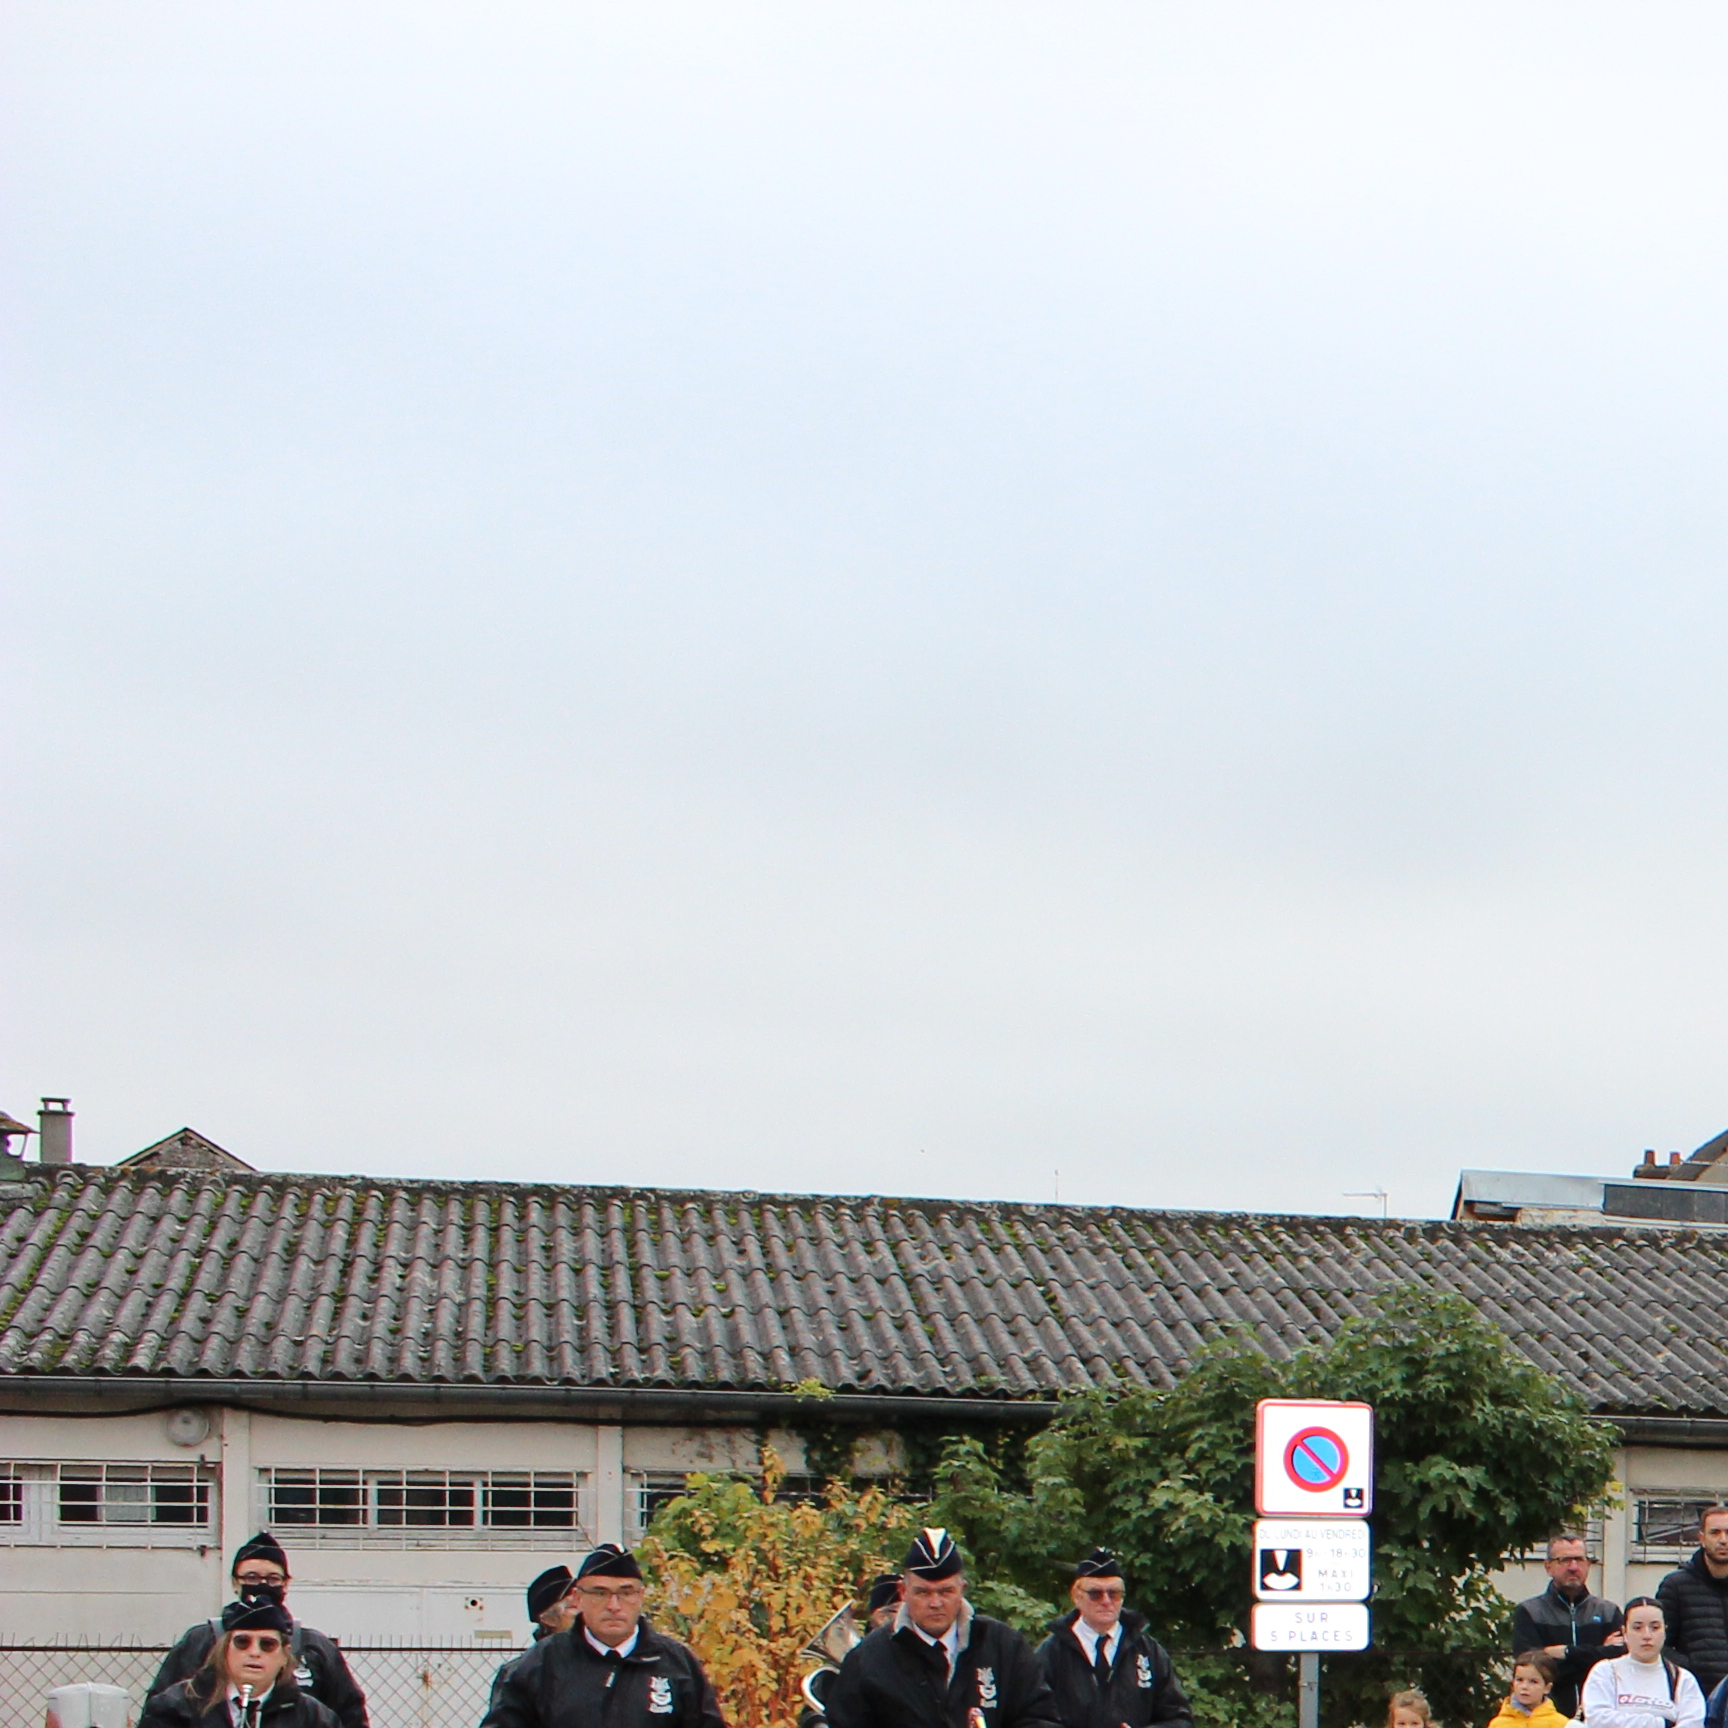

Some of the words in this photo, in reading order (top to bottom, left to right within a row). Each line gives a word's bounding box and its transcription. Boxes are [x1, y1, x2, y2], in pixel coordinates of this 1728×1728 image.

[1259, 1528, 1272, 1540] DU
[1274, 1528, 1302, 1540] LUNDI
[1305, 1528, 1318, 1540] AU
[1320, 1528, 1366, 1540] VENDREDI
[1318, 1569, 1353, 1579] MAXI
[1294, 1612, 1329, 1624] SUR
[1288, 1630, 1353, 1642] PLACES
